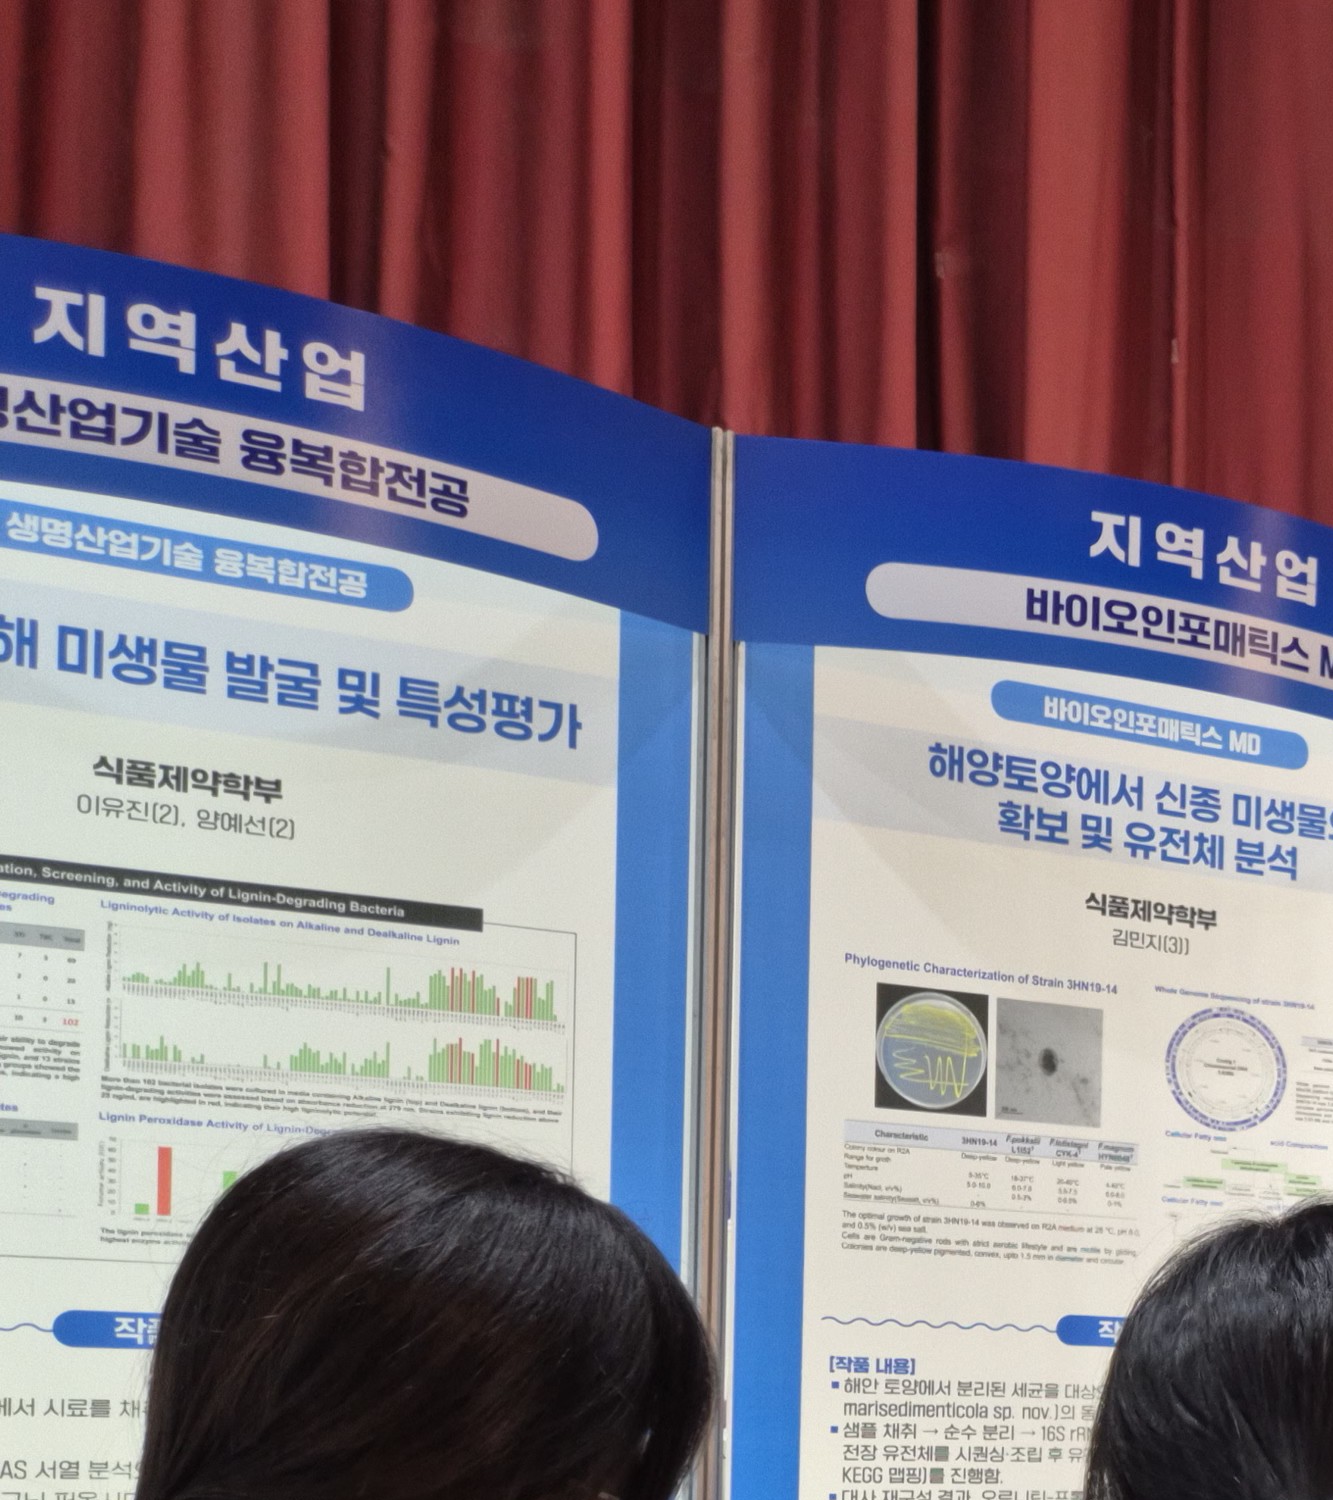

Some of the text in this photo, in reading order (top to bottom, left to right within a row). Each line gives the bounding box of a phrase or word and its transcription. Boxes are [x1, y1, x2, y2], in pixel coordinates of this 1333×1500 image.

[33, 286, 366, 412] 지역산업
[240, 428, 470, 518] 융복합전공
[6, 511, 368, 599] 생명산업기술 융복합전공
[1089, 509, 1320, 608] 지역산업
[1025, 587, 1310, 675] 바이오인포매틱스
[58, 624, 210, 695] 미생물
[226, 651, 323, 711] 발굴
[337, 666, 382, 719] 및
[396, 675, 583, 749] 특성평가
[1043, 694, 1262, 757] 바이오인포매틱스 MD
[93, 755, 283, 804] 식품제약학부
[928, 741, 1145, 813] 해양토양에서
[1155, 782, 1222, 825] 신종
[197, 809, 294, 840] 양예선(2)
[997, 800, 1299, 882] 확보 및 유전체 분석
[42, 866, 405, 919] Screening, and Activity of Lignin-Degrading Bacteria
[1085, 892, 1217, 931] 식품제약학부
[100, 899, 460, 947] Ligninolytic Activity of Isolates on Alkaline and Dealkaline Lignin
[1113, 929, 1189, 955] 김민지(3))
[844, 952, 1117, 995] Phylogenetic Characterization of Strain 3HN19-14
[98, 1112, 136, 1124] Lignin
[138, 1114, 203, 1127] Peroxidase
[206, 1119, 249, 1132] Activity
[875, 1129, 928, 1142] Characteristic
[829, 1356, 916, 1375] [작품 내용]
[44, 1398, 111, 1418] 시료를
[844, 1378, 1059, 1399] 해안 토양에서 분리된 세균을
[843, 1401, 988, 1418] marisedimenticola
[993, 1405, 1014, 1421] sp.
[843, 1422, 1065, 1442] 샘플 채취 순수 분리 16S
[35, 1460, 80, 1479] 서열
[843, 1444, 877, 1461] 전장
[883, 1445, 949, 1462] 유전체를
[842, 1467, 883, 1483] KEGG
[951, 1468, 1003, 1484] 진행함.
